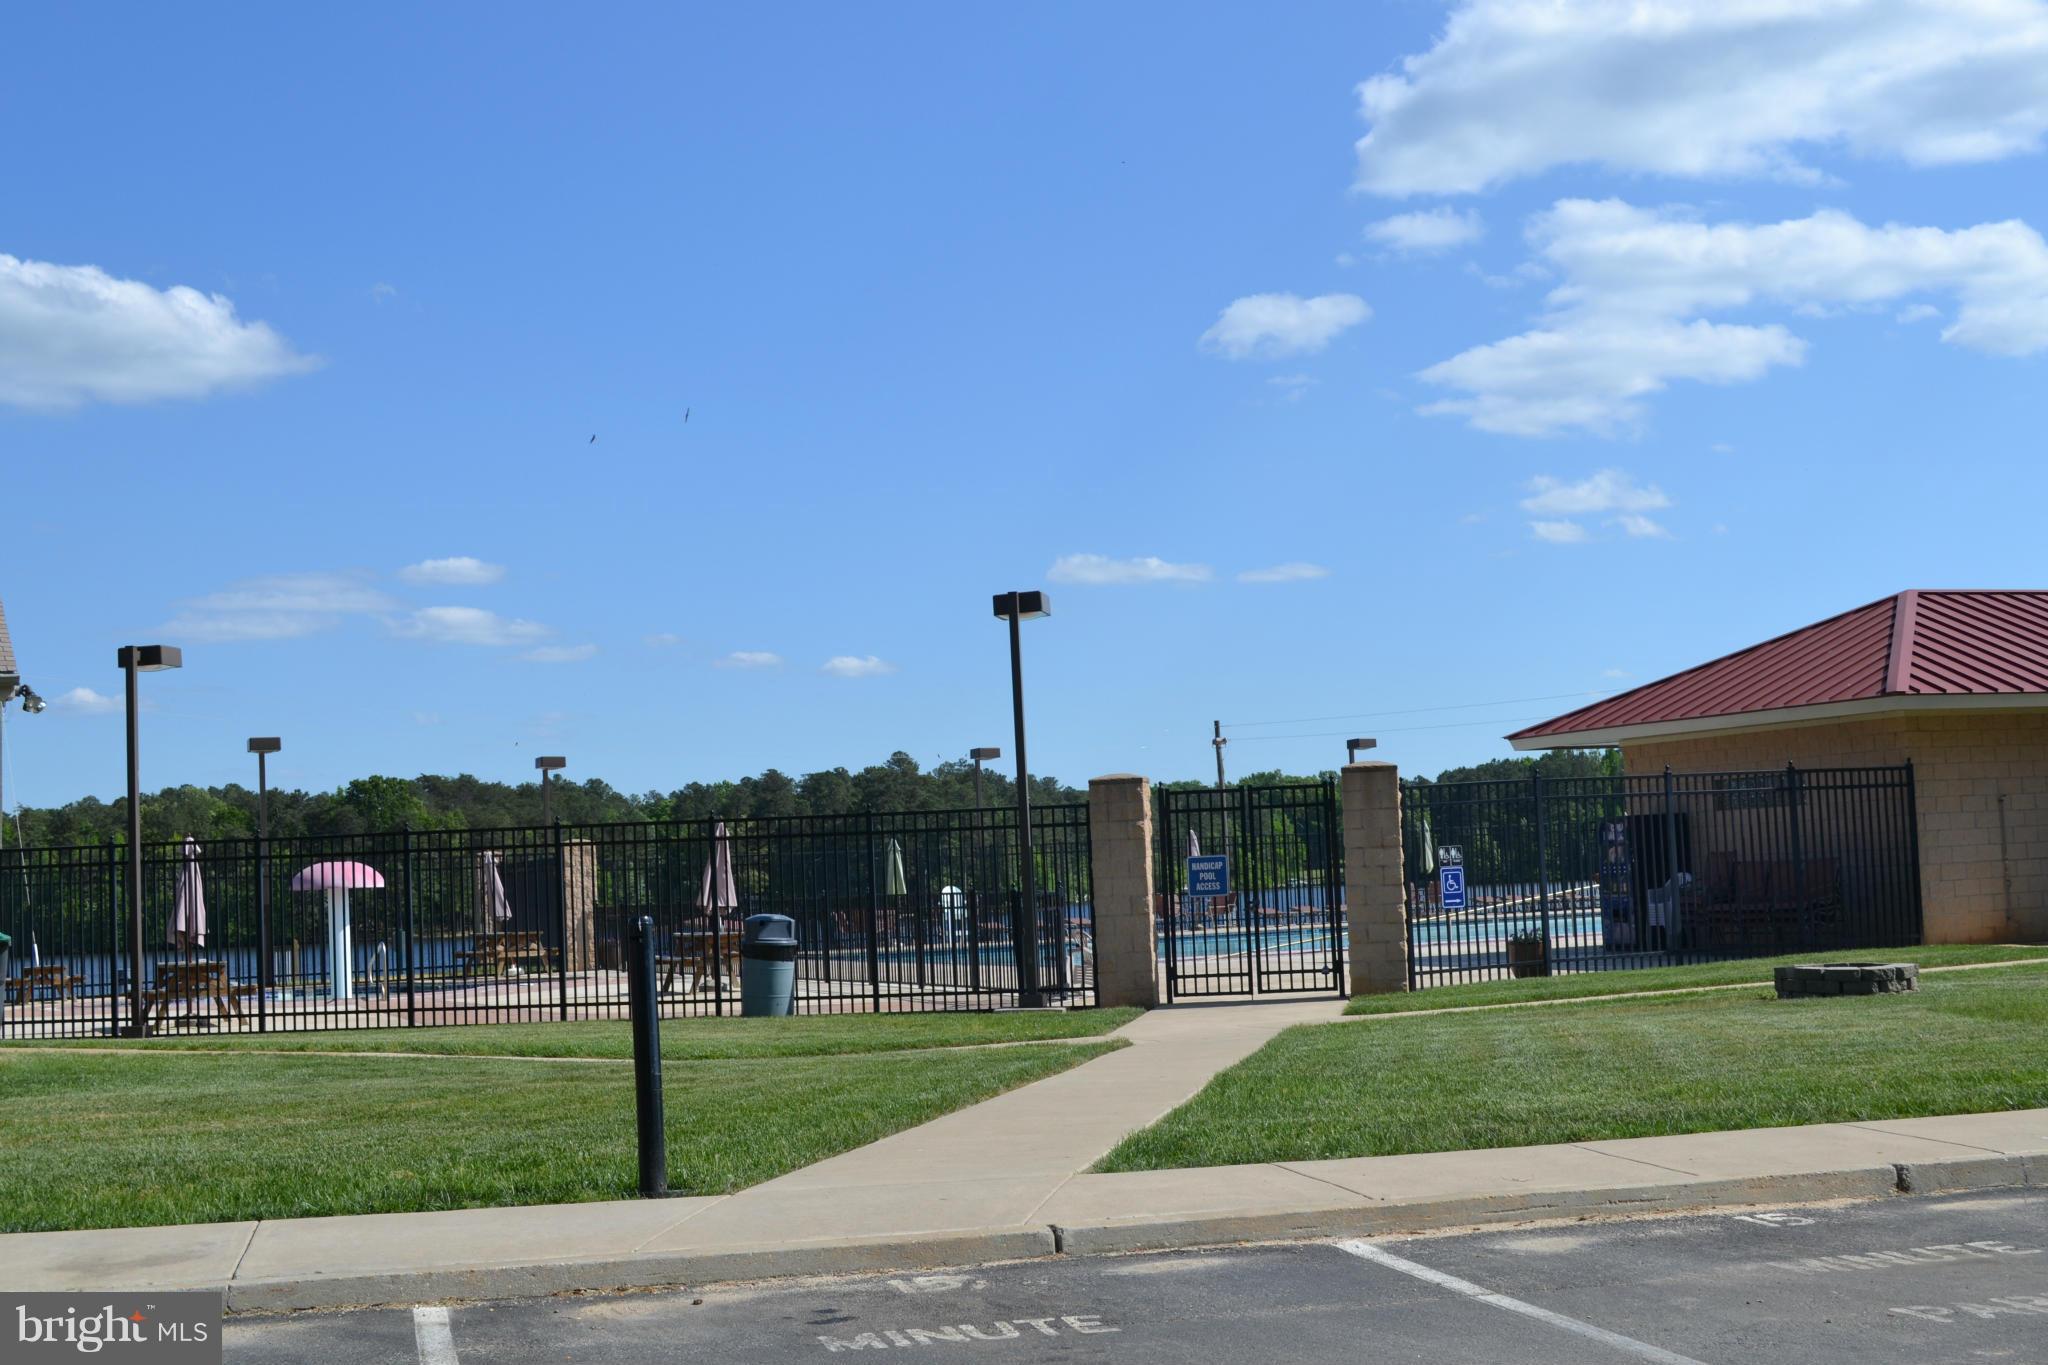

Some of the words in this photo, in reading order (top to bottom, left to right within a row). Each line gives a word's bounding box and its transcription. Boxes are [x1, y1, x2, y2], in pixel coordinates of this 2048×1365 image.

[1191, 861, 1223, 871] HANDICAP
[1199, 872, 1216, 880] POOL
[1196, 882, 1221, 891] ACCESS
[1733, 1213, 1816, 1227] 15
[1766, 1241, 2042, 1275] MINUTE
[1887, 1292, 2048, 1323] PAR
[816, 1313, 1122, 1352] MINUTE
